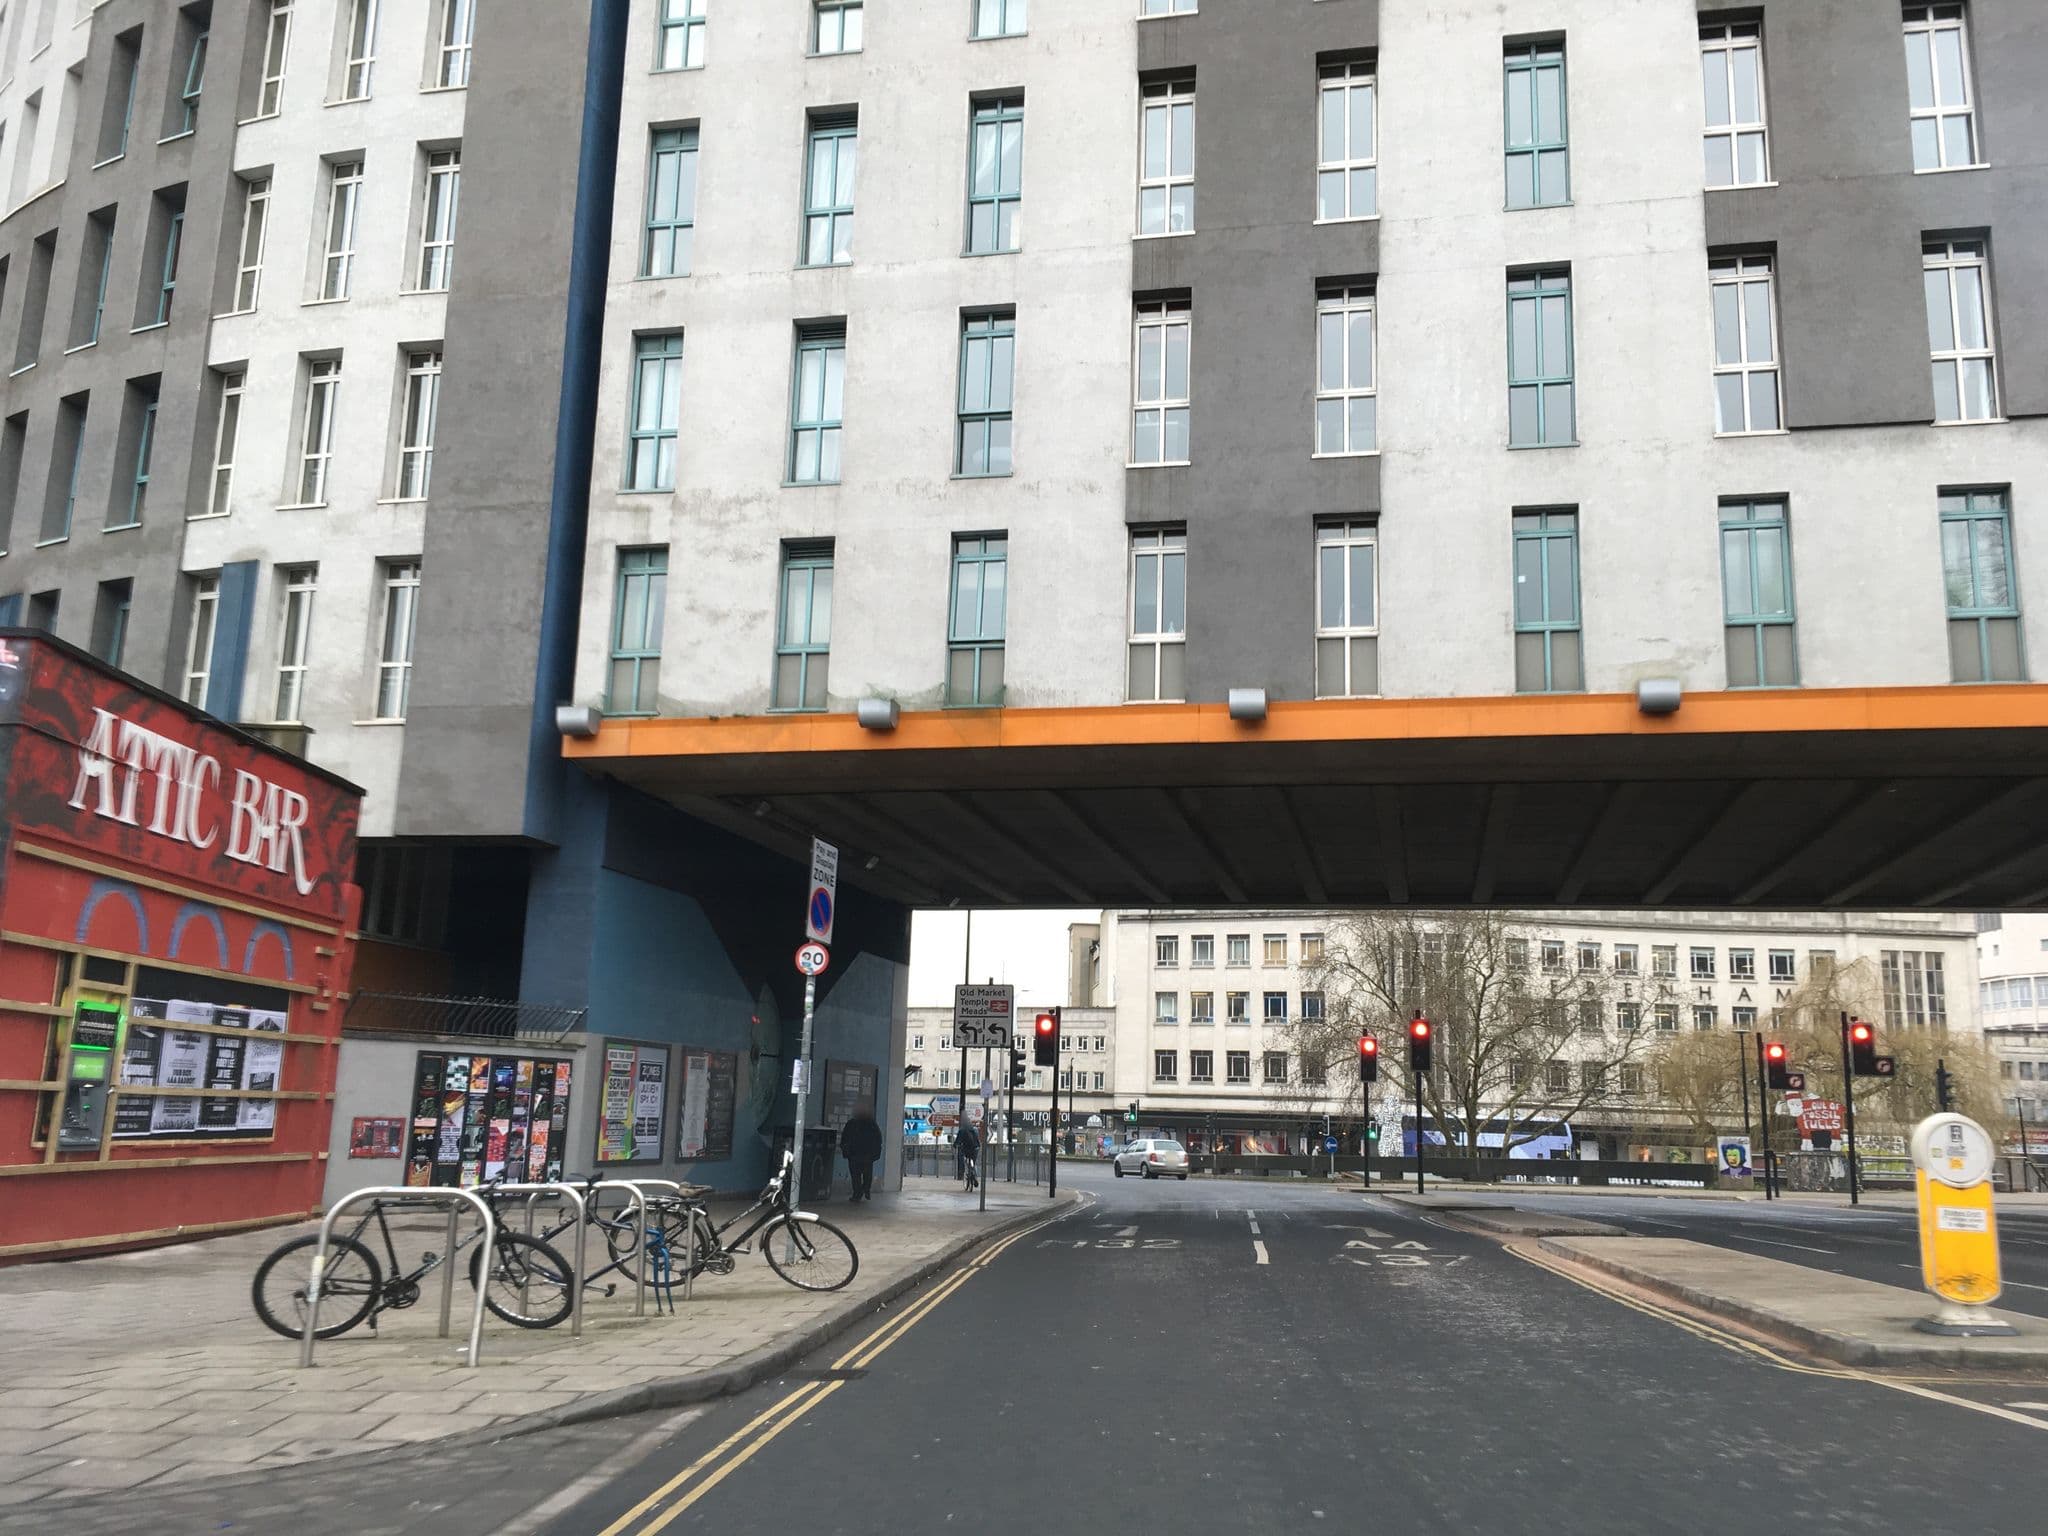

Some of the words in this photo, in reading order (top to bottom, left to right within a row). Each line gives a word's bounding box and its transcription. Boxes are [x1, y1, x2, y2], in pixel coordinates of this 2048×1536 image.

[67, 706, 221, 848] ATTIC
[224, 768, 319, 896] BAR
[814, 867, 835, 888] ZONE
[960, 988, 975, 997] Old
[978, 988, 1006, 997] Market
[960, 998, 989, 1007] Temple
[1022, 1112, 1037, 1121] JUST
[1038, 1112, 1051, 1121] FO
[1802, 1110, 1841, 1120] FOSSIL
